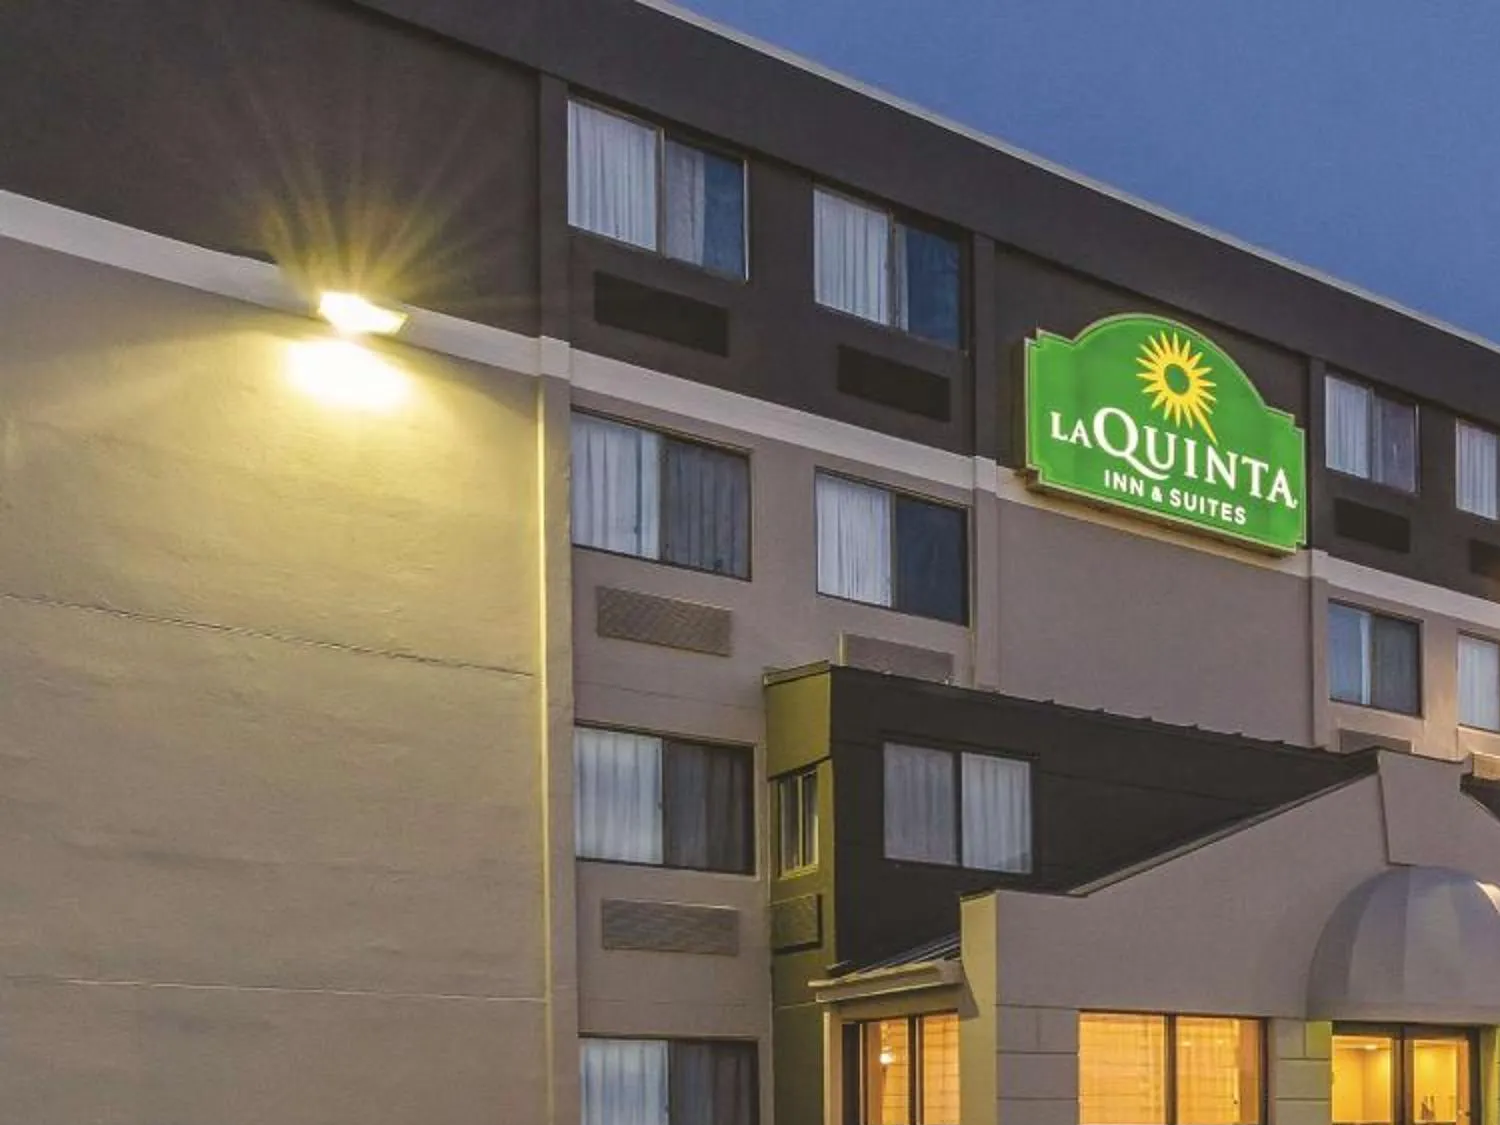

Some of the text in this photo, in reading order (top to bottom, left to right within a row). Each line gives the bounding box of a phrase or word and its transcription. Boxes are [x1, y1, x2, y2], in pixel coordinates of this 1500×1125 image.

[1103, 469, 1247, 526] INN & SUITES
